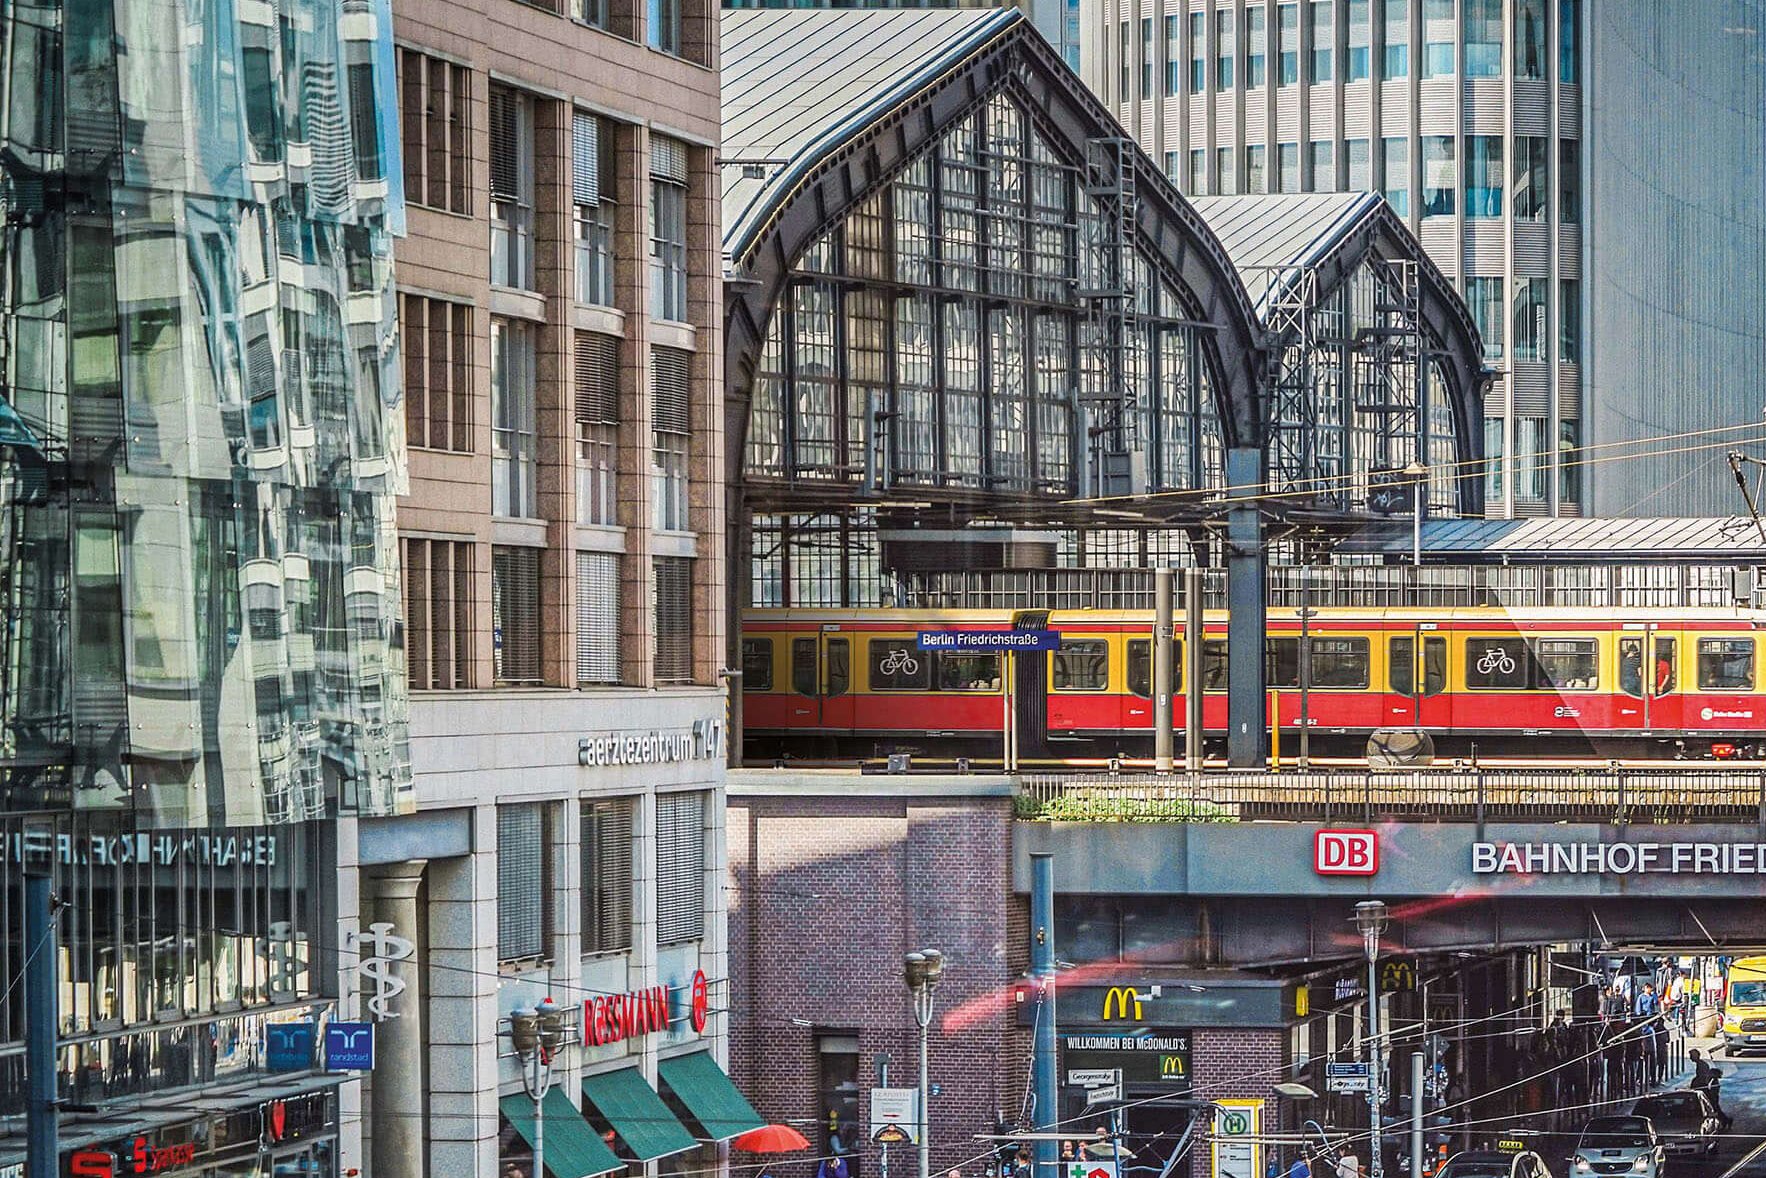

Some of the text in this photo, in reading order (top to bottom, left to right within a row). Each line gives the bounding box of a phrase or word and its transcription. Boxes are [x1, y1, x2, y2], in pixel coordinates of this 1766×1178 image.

[922, 631, 1039, 648] Berlin Friedrichstraße
[587, 730, 693, 766] aerztezentrum
[1323, 838, 1370, 867] DB
[1473, 843, 1658, 875] BAHNHOF
[584, 985, 670, 1048] ROSSMANN
[330, 1051, 369, 1062] randstad
[1067, 1037, 1120, 1050] WILLKOMMEN
[1122, 1037, 1135, 1050] BEI
